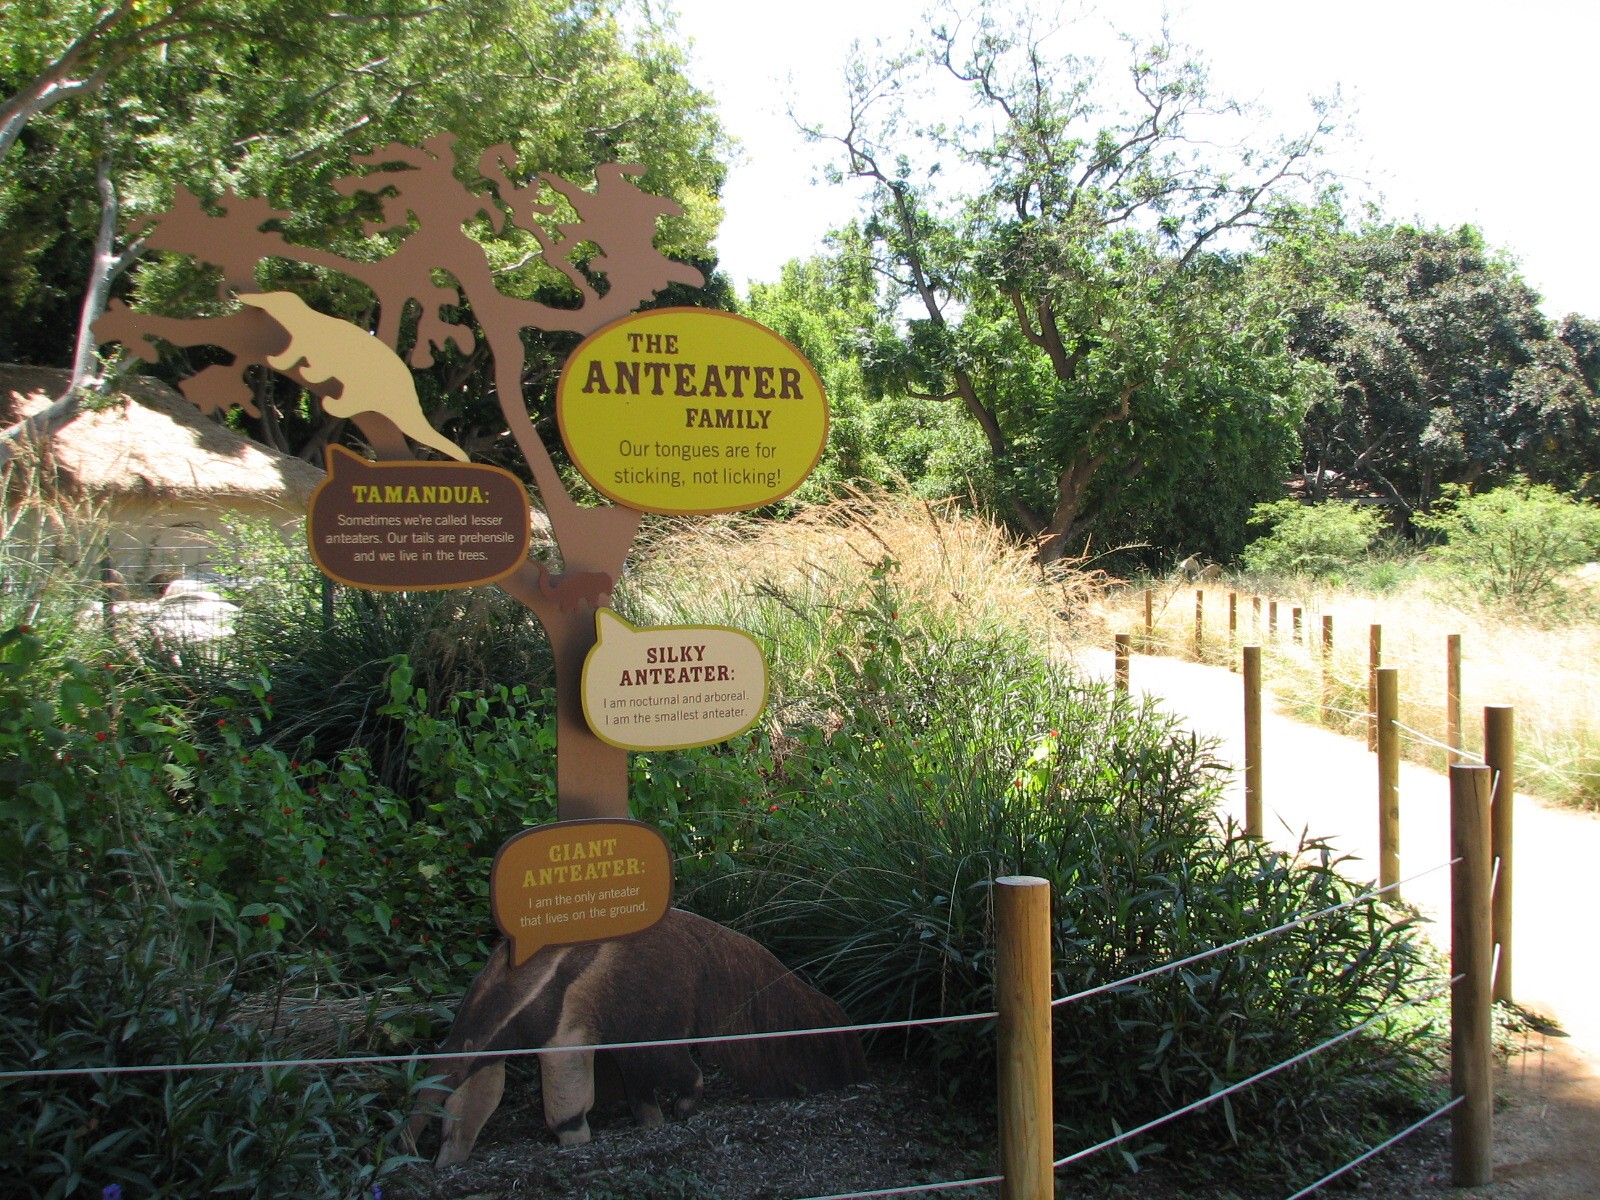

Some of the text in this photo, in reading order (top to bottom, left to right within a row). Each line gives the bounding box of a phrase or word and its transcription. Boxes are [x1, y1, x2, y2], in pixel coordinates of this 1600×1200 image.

[627, 333, 679, 354] THE
[582, 360, 803, 400] ANTEATER
[685, 408, 772, 429] FAMILY
[619, 440, 777, 461] Our tongues are for
[614, 468, 781, 487] sticking, not licking!
[353, 486, 490, 503] TAMANDUA:
[338, 514, 503, 526] Sometimes we're called lesser
[325, 532, 514, 545] anteaters. Our tails are prehensile
[354, 550, 488, 562] and we live in the trees.
[647, 645, 706, 663] SILKY
[619, 665, 735, 686] ANTEATER:
[610, 700, 626, 708] am
[629, 694, 680, 707] nocturnal
[683, 693, 701, 704] and
[705, 690, 749, 702] arboreal.
[613, 715, 630, 724] am
[634, 713, 650, 724] the
[654, 710, 698, 722] smallest
[702, 707, 748, 719] anteater.
[549, 839, 617, 862] GIANT
[523, 858, 645, 887] ANTEATER:
[536, 898, 552, 907] am
[555, 895, 572, 905] the
[575, 891, 595, 904] only
[598, 887, 640, 900] anteater
[520, 902, 648, 927] that lives on the ground.
